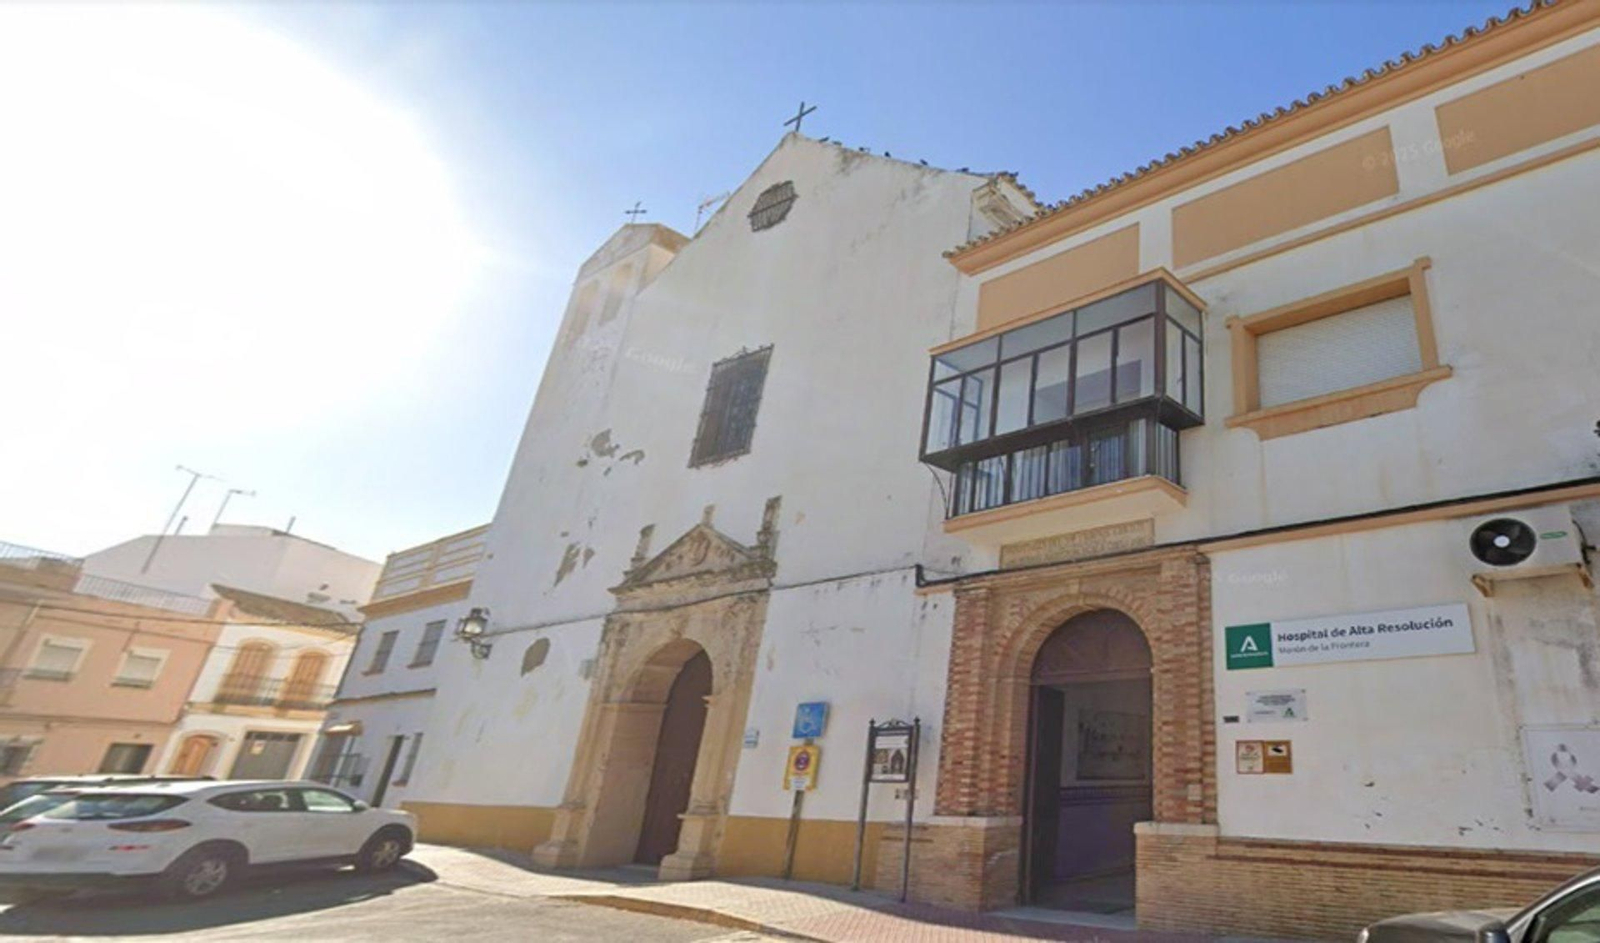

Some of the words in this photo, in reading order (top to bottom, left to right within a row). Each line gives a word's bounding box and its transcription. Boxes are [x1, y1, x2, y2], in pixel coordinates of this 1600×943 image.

[1278, 628, 1328, 643] Hospital
[1331, 627, 1347, 638] de
[1349, 625, 1375, 636] Alta
[1378, 616, 1453, 634] Resolución
[1307, 643, 1319, 652] de
[1321, 642, 1330, 651] la
[1331, 640, 1371, 650] Frontera
